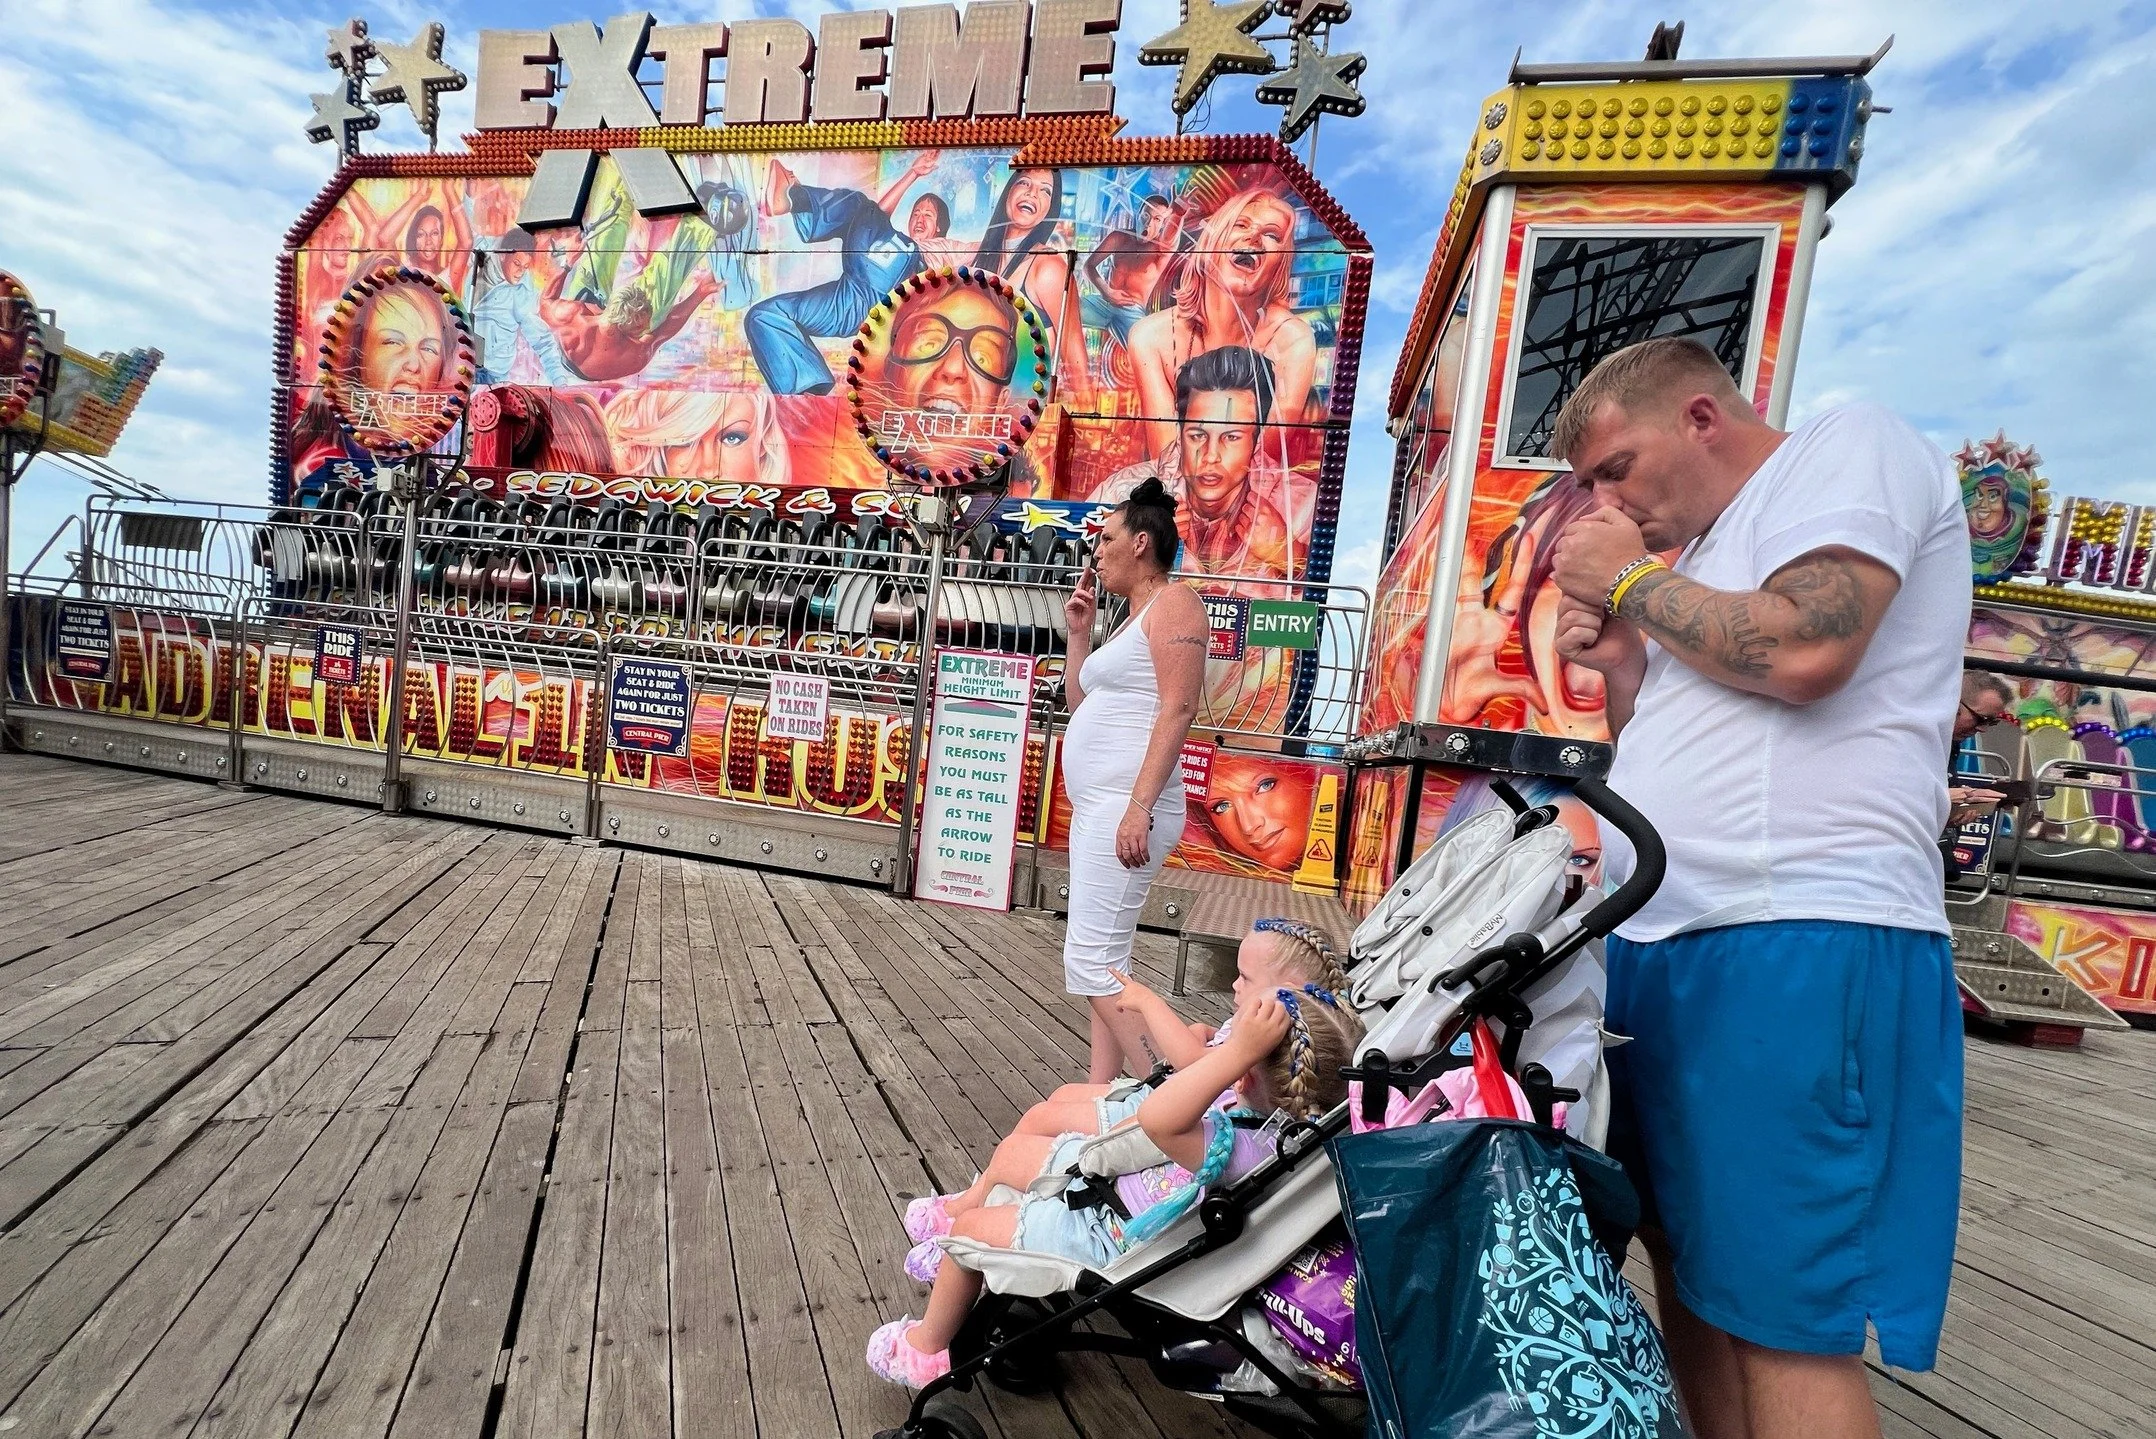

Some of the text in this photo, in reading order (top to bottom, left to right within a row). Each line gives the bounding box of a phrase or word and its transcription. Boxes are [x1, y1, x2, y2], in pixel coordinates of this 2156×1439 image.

[474, 0, 1117, 231] EXTREME
[351, 391, 449, 428] EXTREME
[882, 410, 1012, 453] EXTREME
[505, 471, 781, 510] SEDGWICK
[785, 487, 836, 514] &
[2050, 496, 2156, 592] MI
[1210, 616, 1236, 630] IDE
[1253, 613, 1314, 633] ENTRY
[60, 634, 109, 649] TWO TICKETS
[323, 630, 356, 646] THIS
[1210, 642, 1224, 650] KETS
[323, 642, 355, 658] RIDE
[624, 665, 680, 680] STAY IN YOUR
[941, 654, 1029, 680] EXTREME
[626, 676, 677, 690] SEAT & RIDE
[775, 680, 823, 698] NO CASH
[961, 676, 1004, 688] MINIMUM
[617, 687, 684, 702] AGAIN FOR JUST
[944, 683, 1021, 699] HEIGHT LIMIT
[614, 699, 685, 717] TWO TICKETS
[778, 698, 818, 717] TAKEN
[770, 716, 822, 736] ON RIDES
[938, 724, 1018, 744] FOR SAFETY
[625, 730, 669, 742] CENTRAL PIER
[945, 746, 1006, 763] REASONS
[1187, 755, 1201, 766] RIDE
[1201, 757, 1208, 767] IS
[939, 766, 1008, 784] YOU MUST
[1181, 768, 1205, 782] SED FOR
[934, 785, 1008, 804] BE AS TALL
[1182, 782, 1207, 796] ENANCE
[945, 808, 993, 823] AS THE
[941, 827, 993, 843] ARROW
[1961, 822, 1990, 834] KETS
[938, 846, 992, 864] TO RIDE
[2042, 917, 2156, 1001] KI
